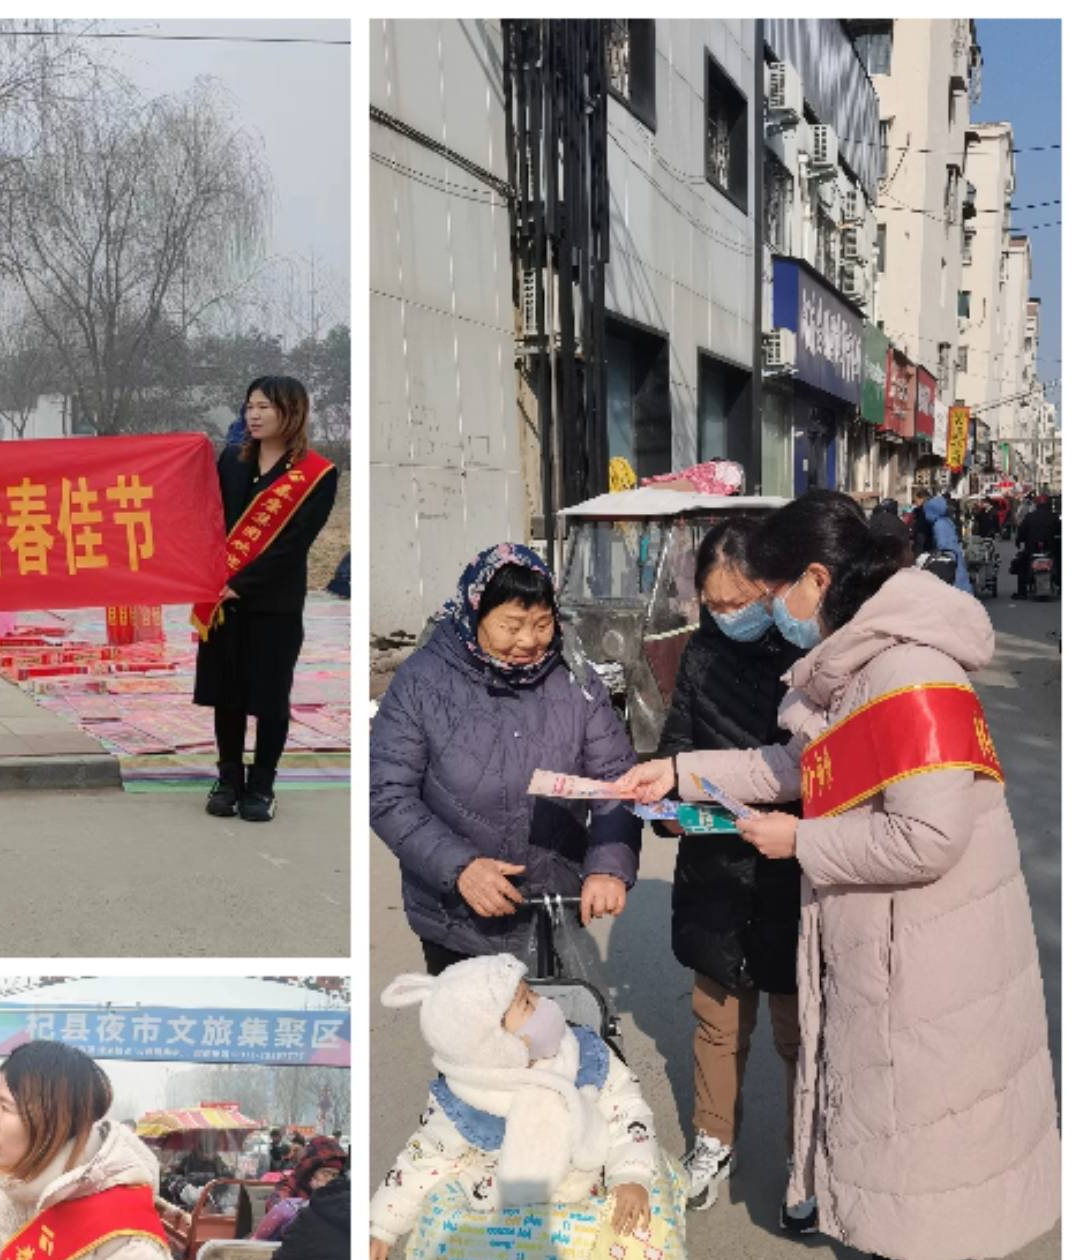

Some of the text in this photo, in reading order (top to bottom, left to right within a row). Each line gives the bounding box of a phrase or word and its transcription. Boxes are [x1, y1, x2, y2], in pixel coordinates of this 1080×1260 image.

[26, 1012, 345, 1050] 杞县夜市文旅集聚区
